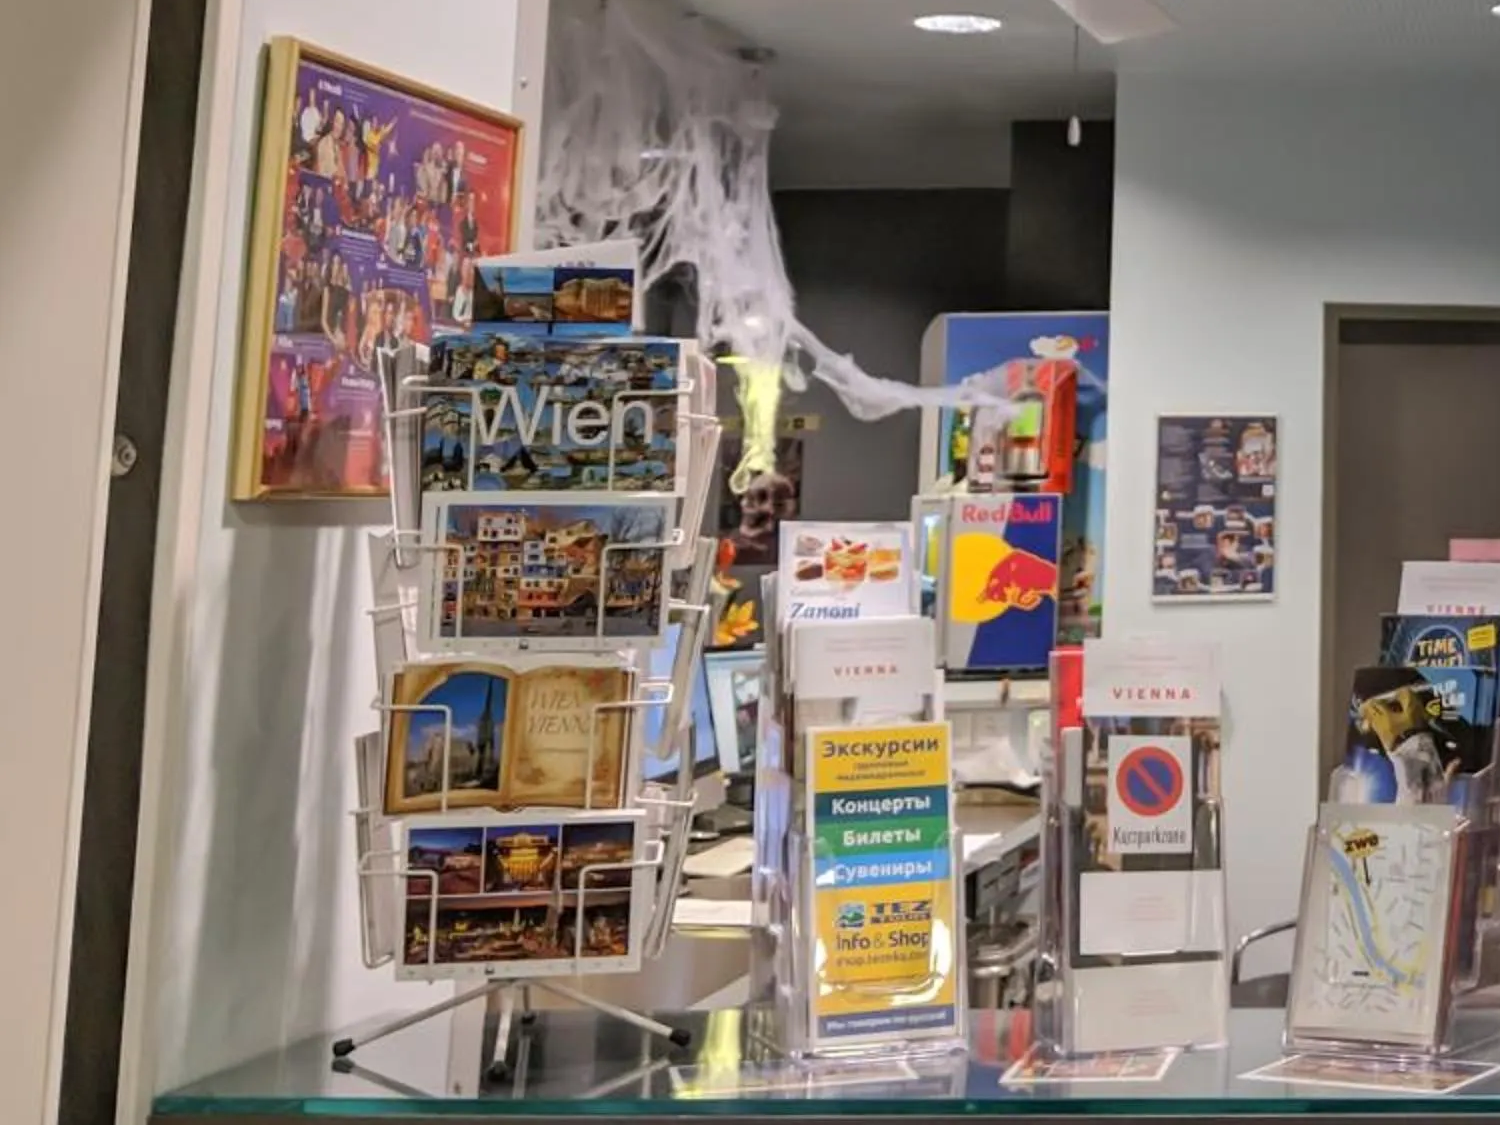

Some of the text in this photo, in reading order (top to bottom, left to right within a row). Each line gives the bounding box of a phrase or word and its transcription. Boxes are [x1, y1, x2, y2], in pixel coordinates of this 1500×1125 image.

[473, 386, 653, 446] Wien
[961, 502, 1054, 524] Red Bull
[790, 602, 861, 620] Zanoni
[833, 664, 898, 677] VIENNA
[1112, 687, 1192, 700] VIENNA
[821, 738, 939, 758] Экскурсии
[831, 796, 932, 815] Концерты
[843, 828, 922, 847] Билеты
[1112, 826, 1188, 849] Kurzparkzone
[834, 860, 933, 884] Сувениры
[869, 900, 932, 915] TEZ
[888, 929, 930, 949] Shop
